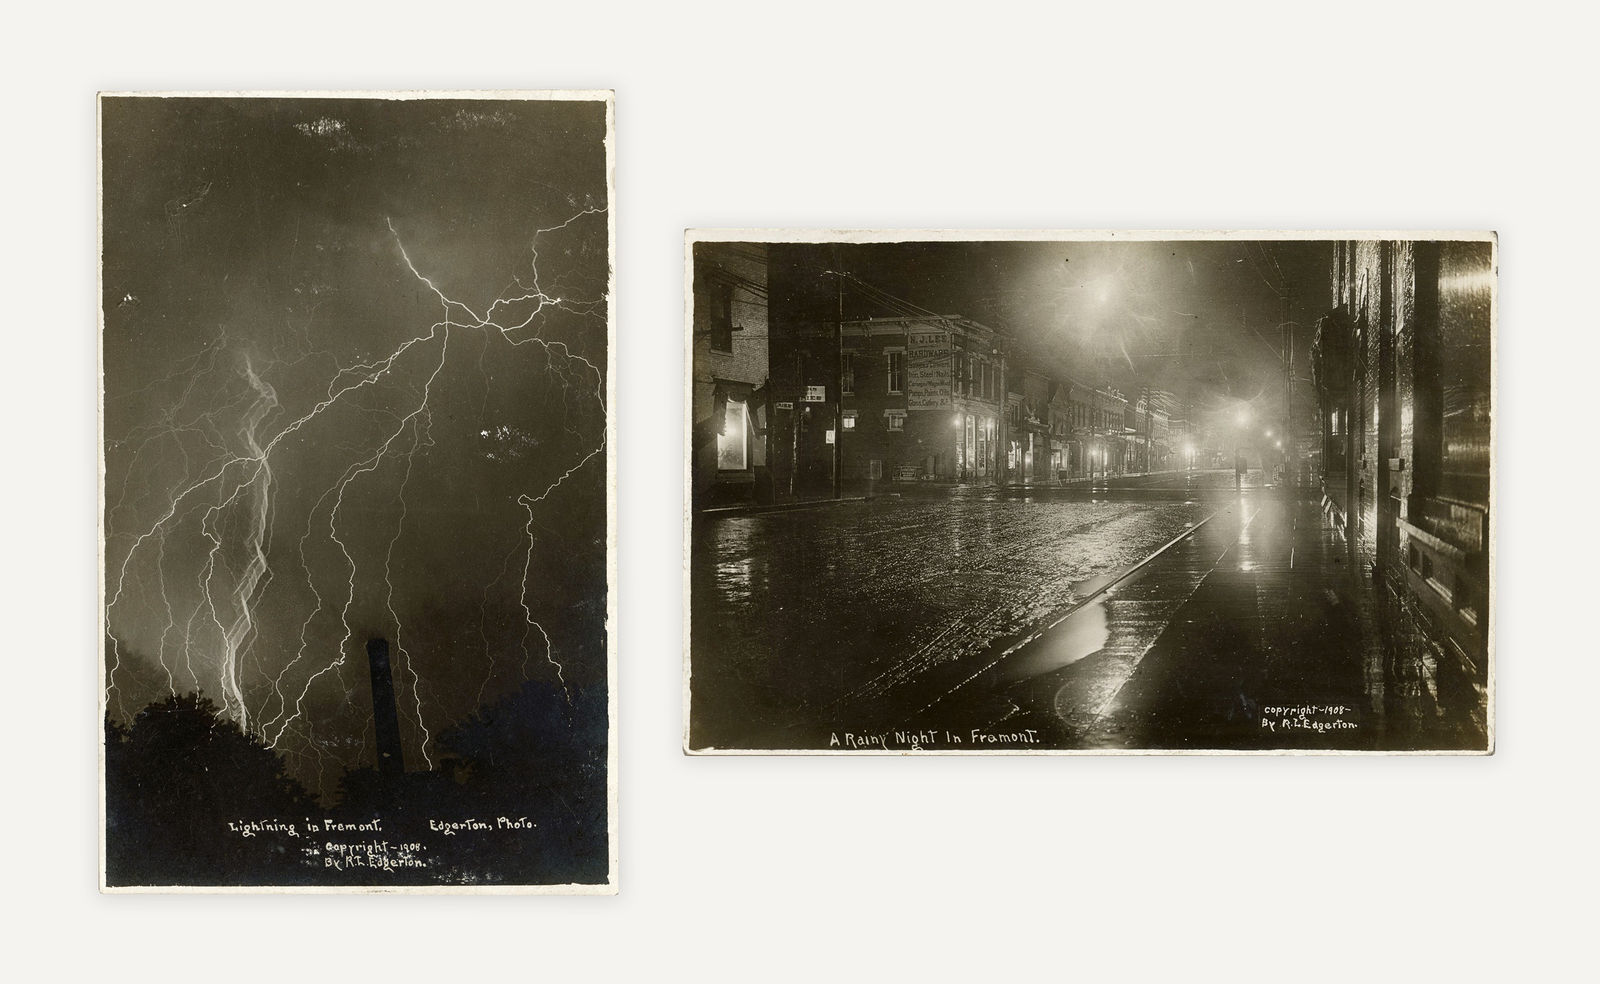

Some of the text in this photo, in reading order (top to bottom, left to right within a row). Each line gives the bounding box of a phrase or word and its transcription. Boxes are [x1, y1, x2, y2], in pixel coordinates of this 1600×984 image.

[1262, 717, 1276, 732] By
[830, 733, 840, 746] A
[846, 730, 888, 749] Rainy
[896, 730, 937, 749] Night
[947, 731, 961, 743] In
[228, 819, 300, 837] Lightning
[305, 817, 320, 832] in
[429, 816, 537, 836] Edgerton, Photo.
[325, 857, 343, 871] By
